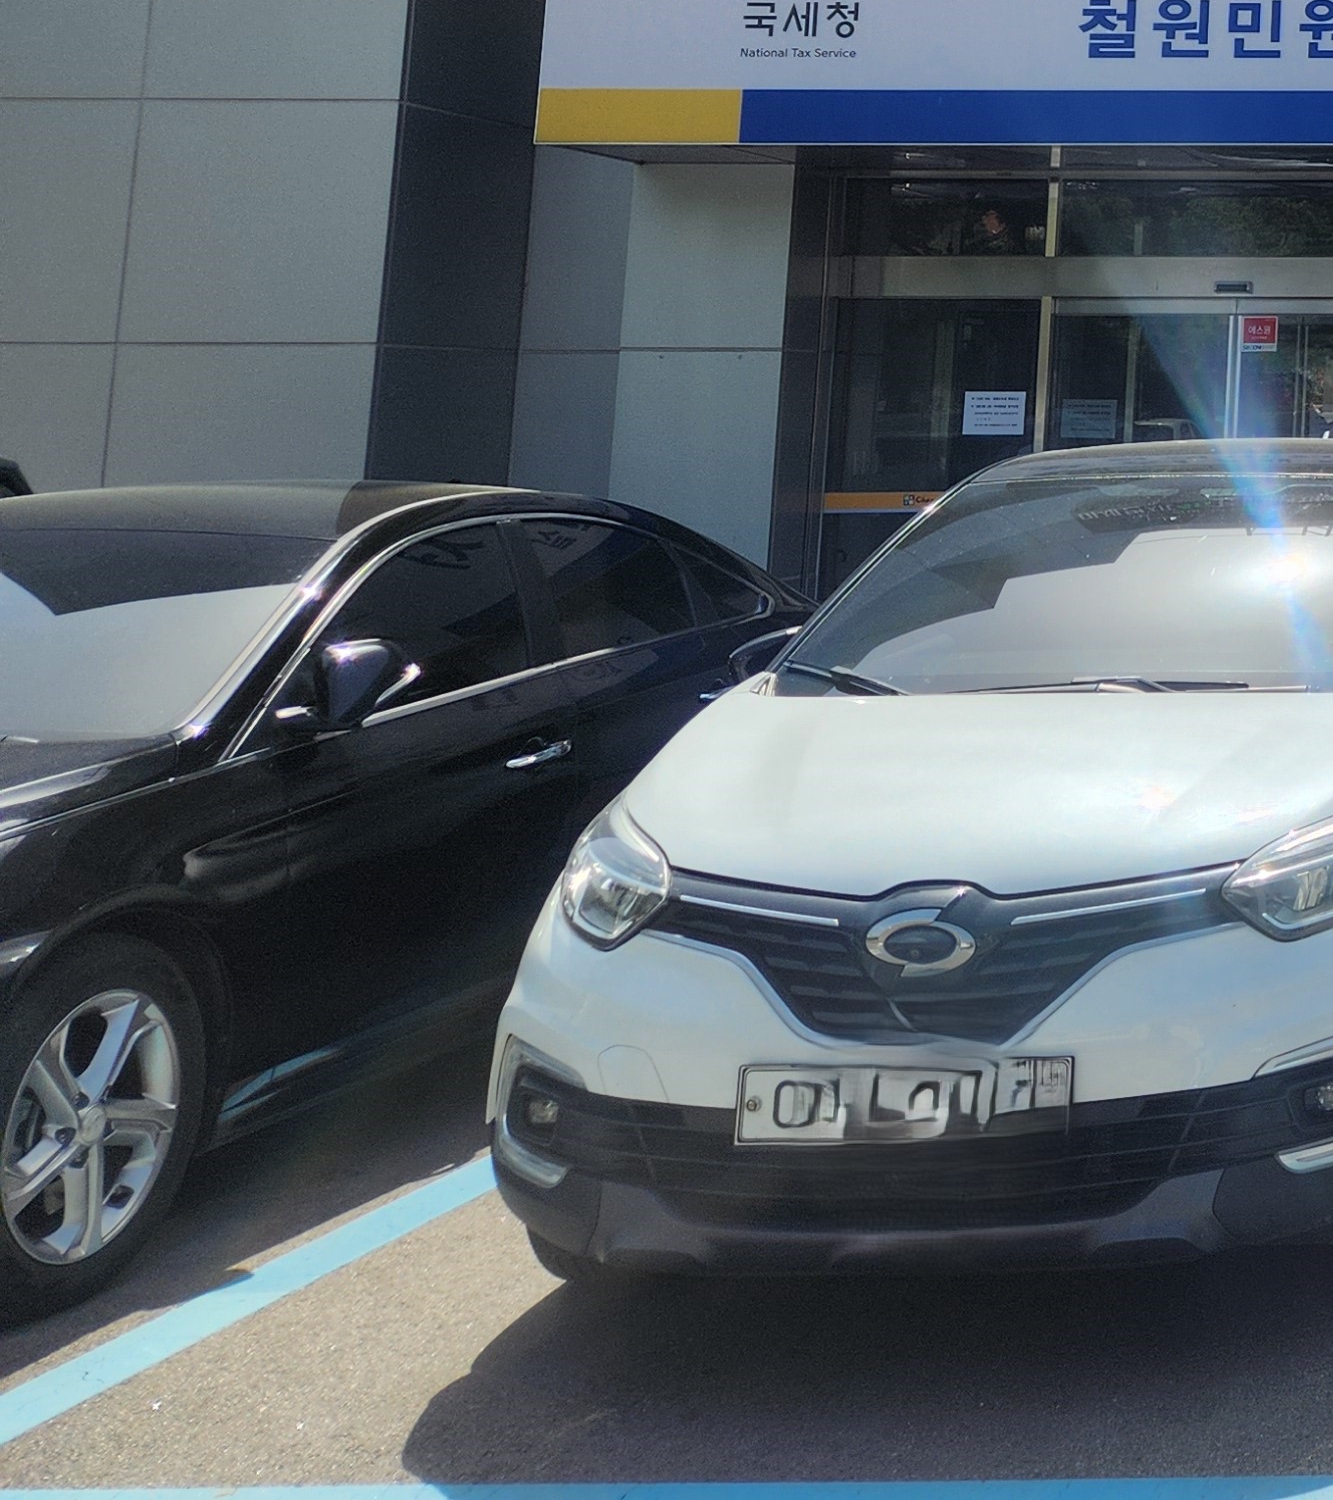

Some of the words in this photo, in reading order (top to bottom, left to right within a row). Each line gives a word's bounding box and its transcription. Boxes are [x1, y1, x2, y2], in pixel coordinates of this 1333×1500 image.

[742, 1, 860, 39] 국세청
[740, 47, 788, 58] National
[791, 47, 811, 58] Tax
[814, 47, 857, 58] Service
